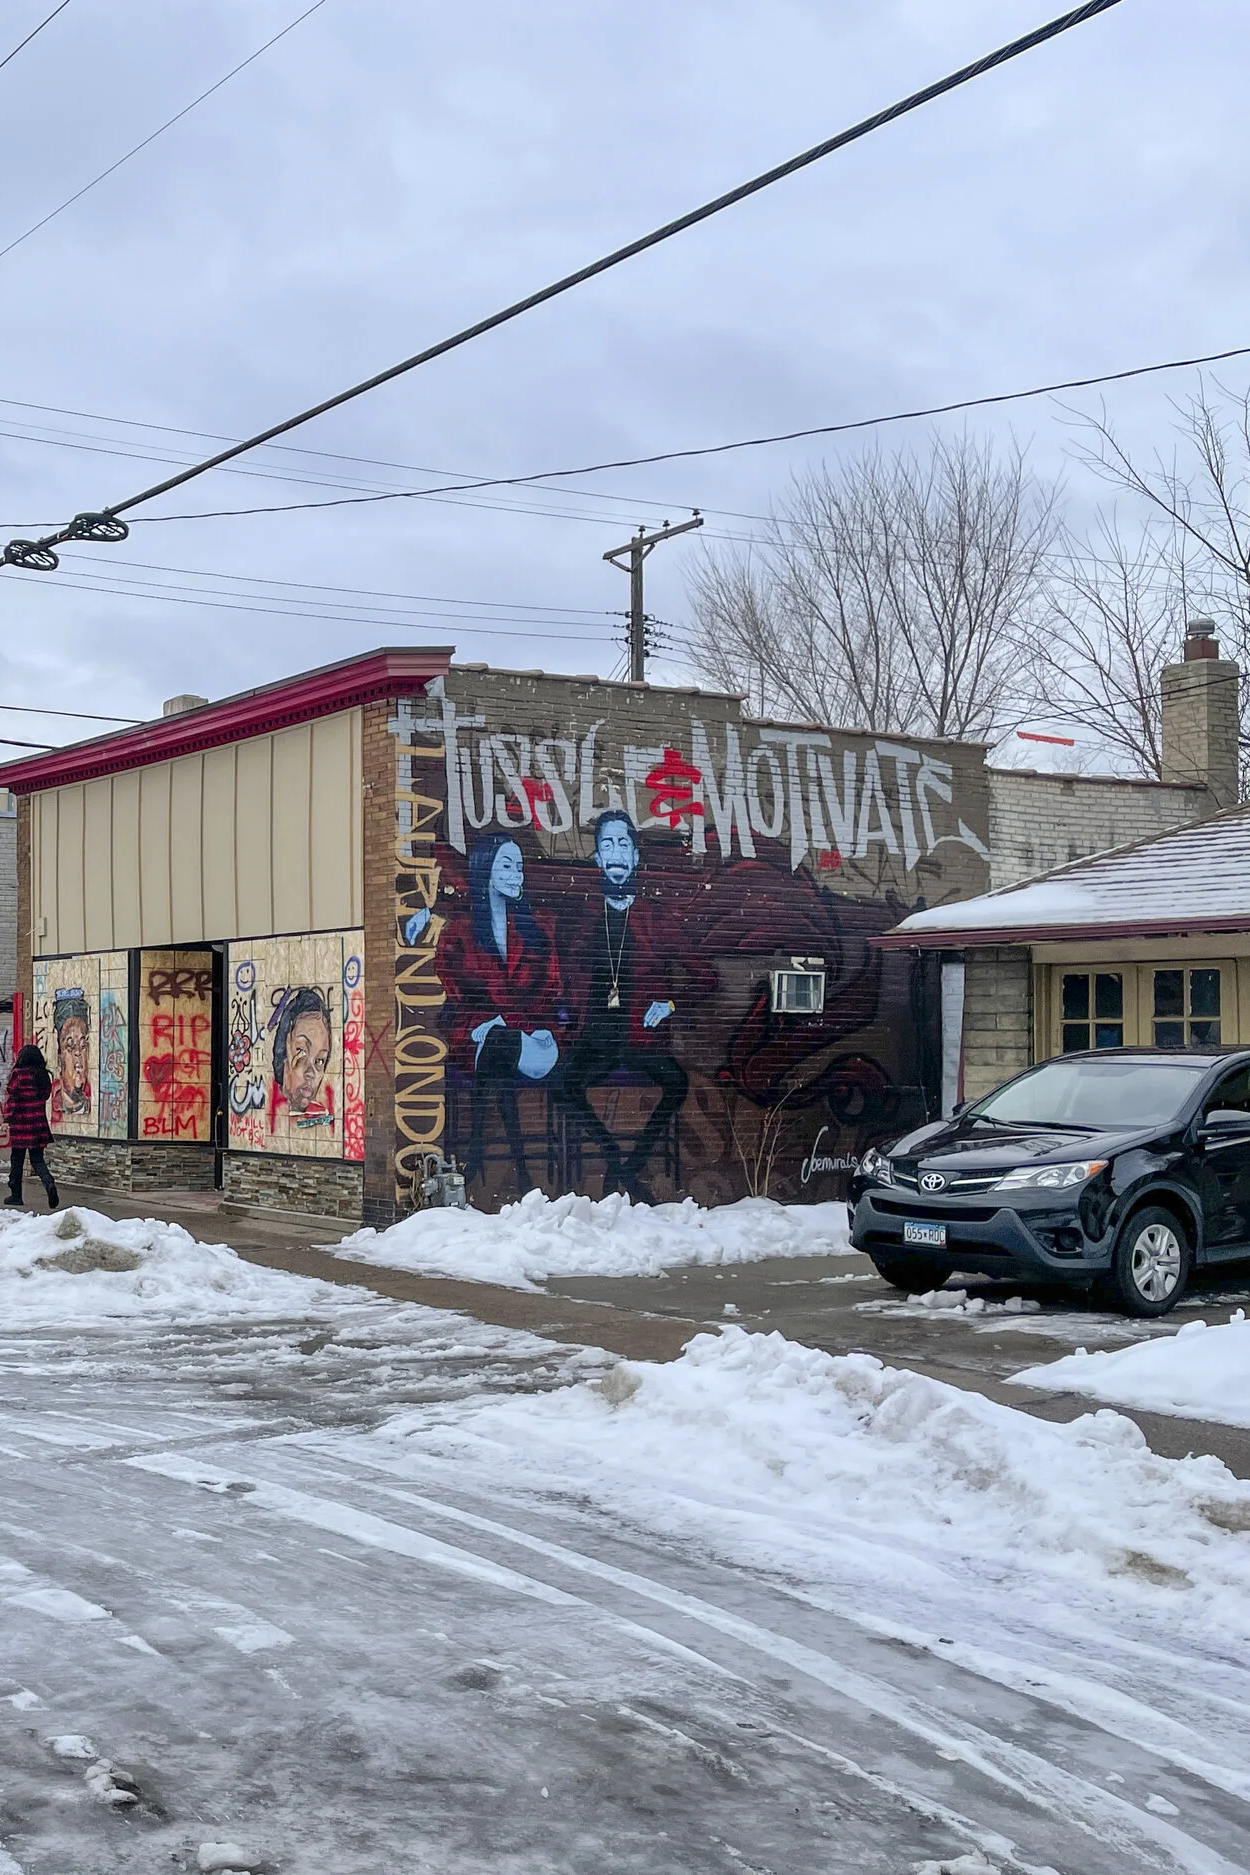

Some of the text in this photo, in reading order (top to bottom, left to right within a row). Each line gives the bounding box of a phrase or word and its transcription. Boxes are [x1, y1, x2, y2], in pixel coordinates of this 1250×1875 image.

[691, 715, 990, 876] MOTIVATE
[150, 1014, 211, 1048] RIP
[143, 1114, 198, 1140] BLM
[394, 984, 448, 1205] LONDO
